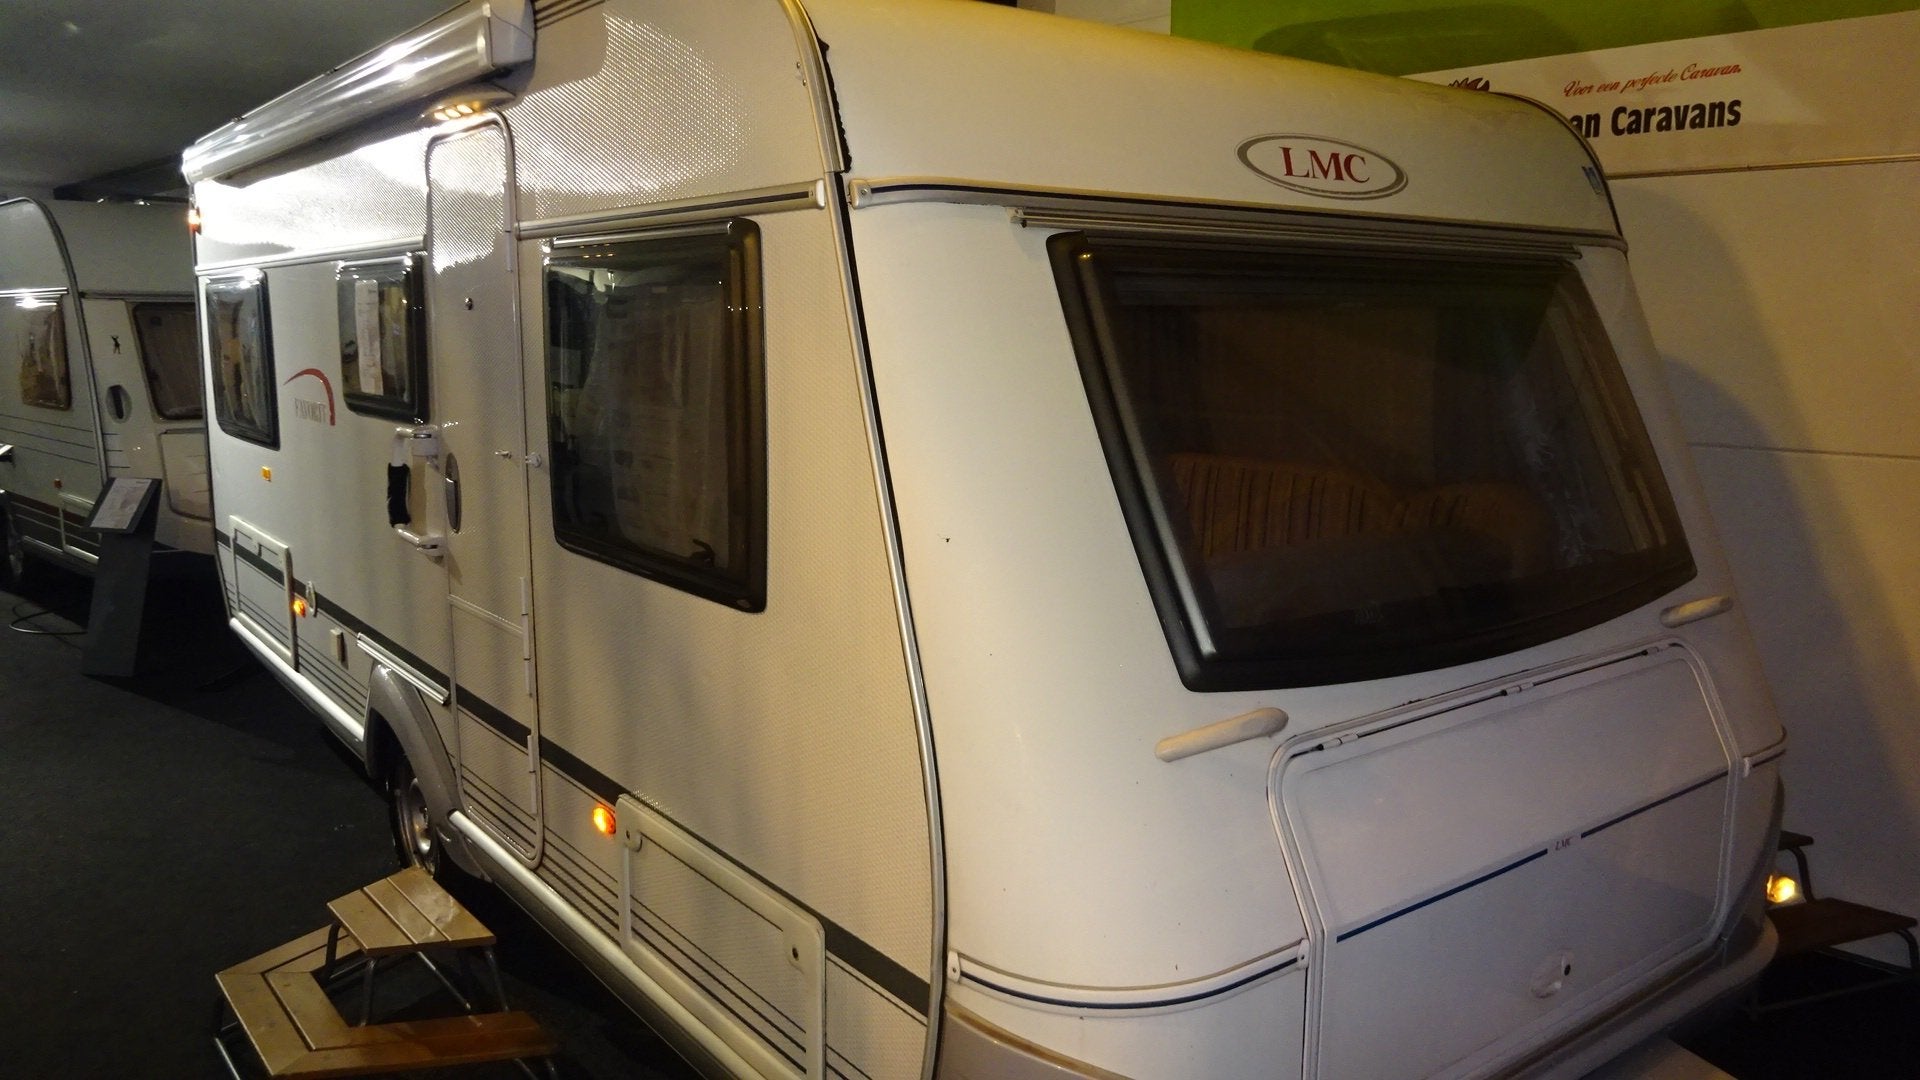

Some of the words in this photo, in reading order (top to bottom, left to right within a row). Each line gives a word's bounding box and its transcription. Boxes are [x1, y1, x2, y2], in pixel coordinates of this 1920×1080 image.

[1564, 80, 1592, 97] Voor
[1597, 81, 1620, 93] een
[1620, 69, 1678, 94] perfecte
[1611, 99, 1742, 136] Caravans
[1279, 146, 1370, 184] LMC
